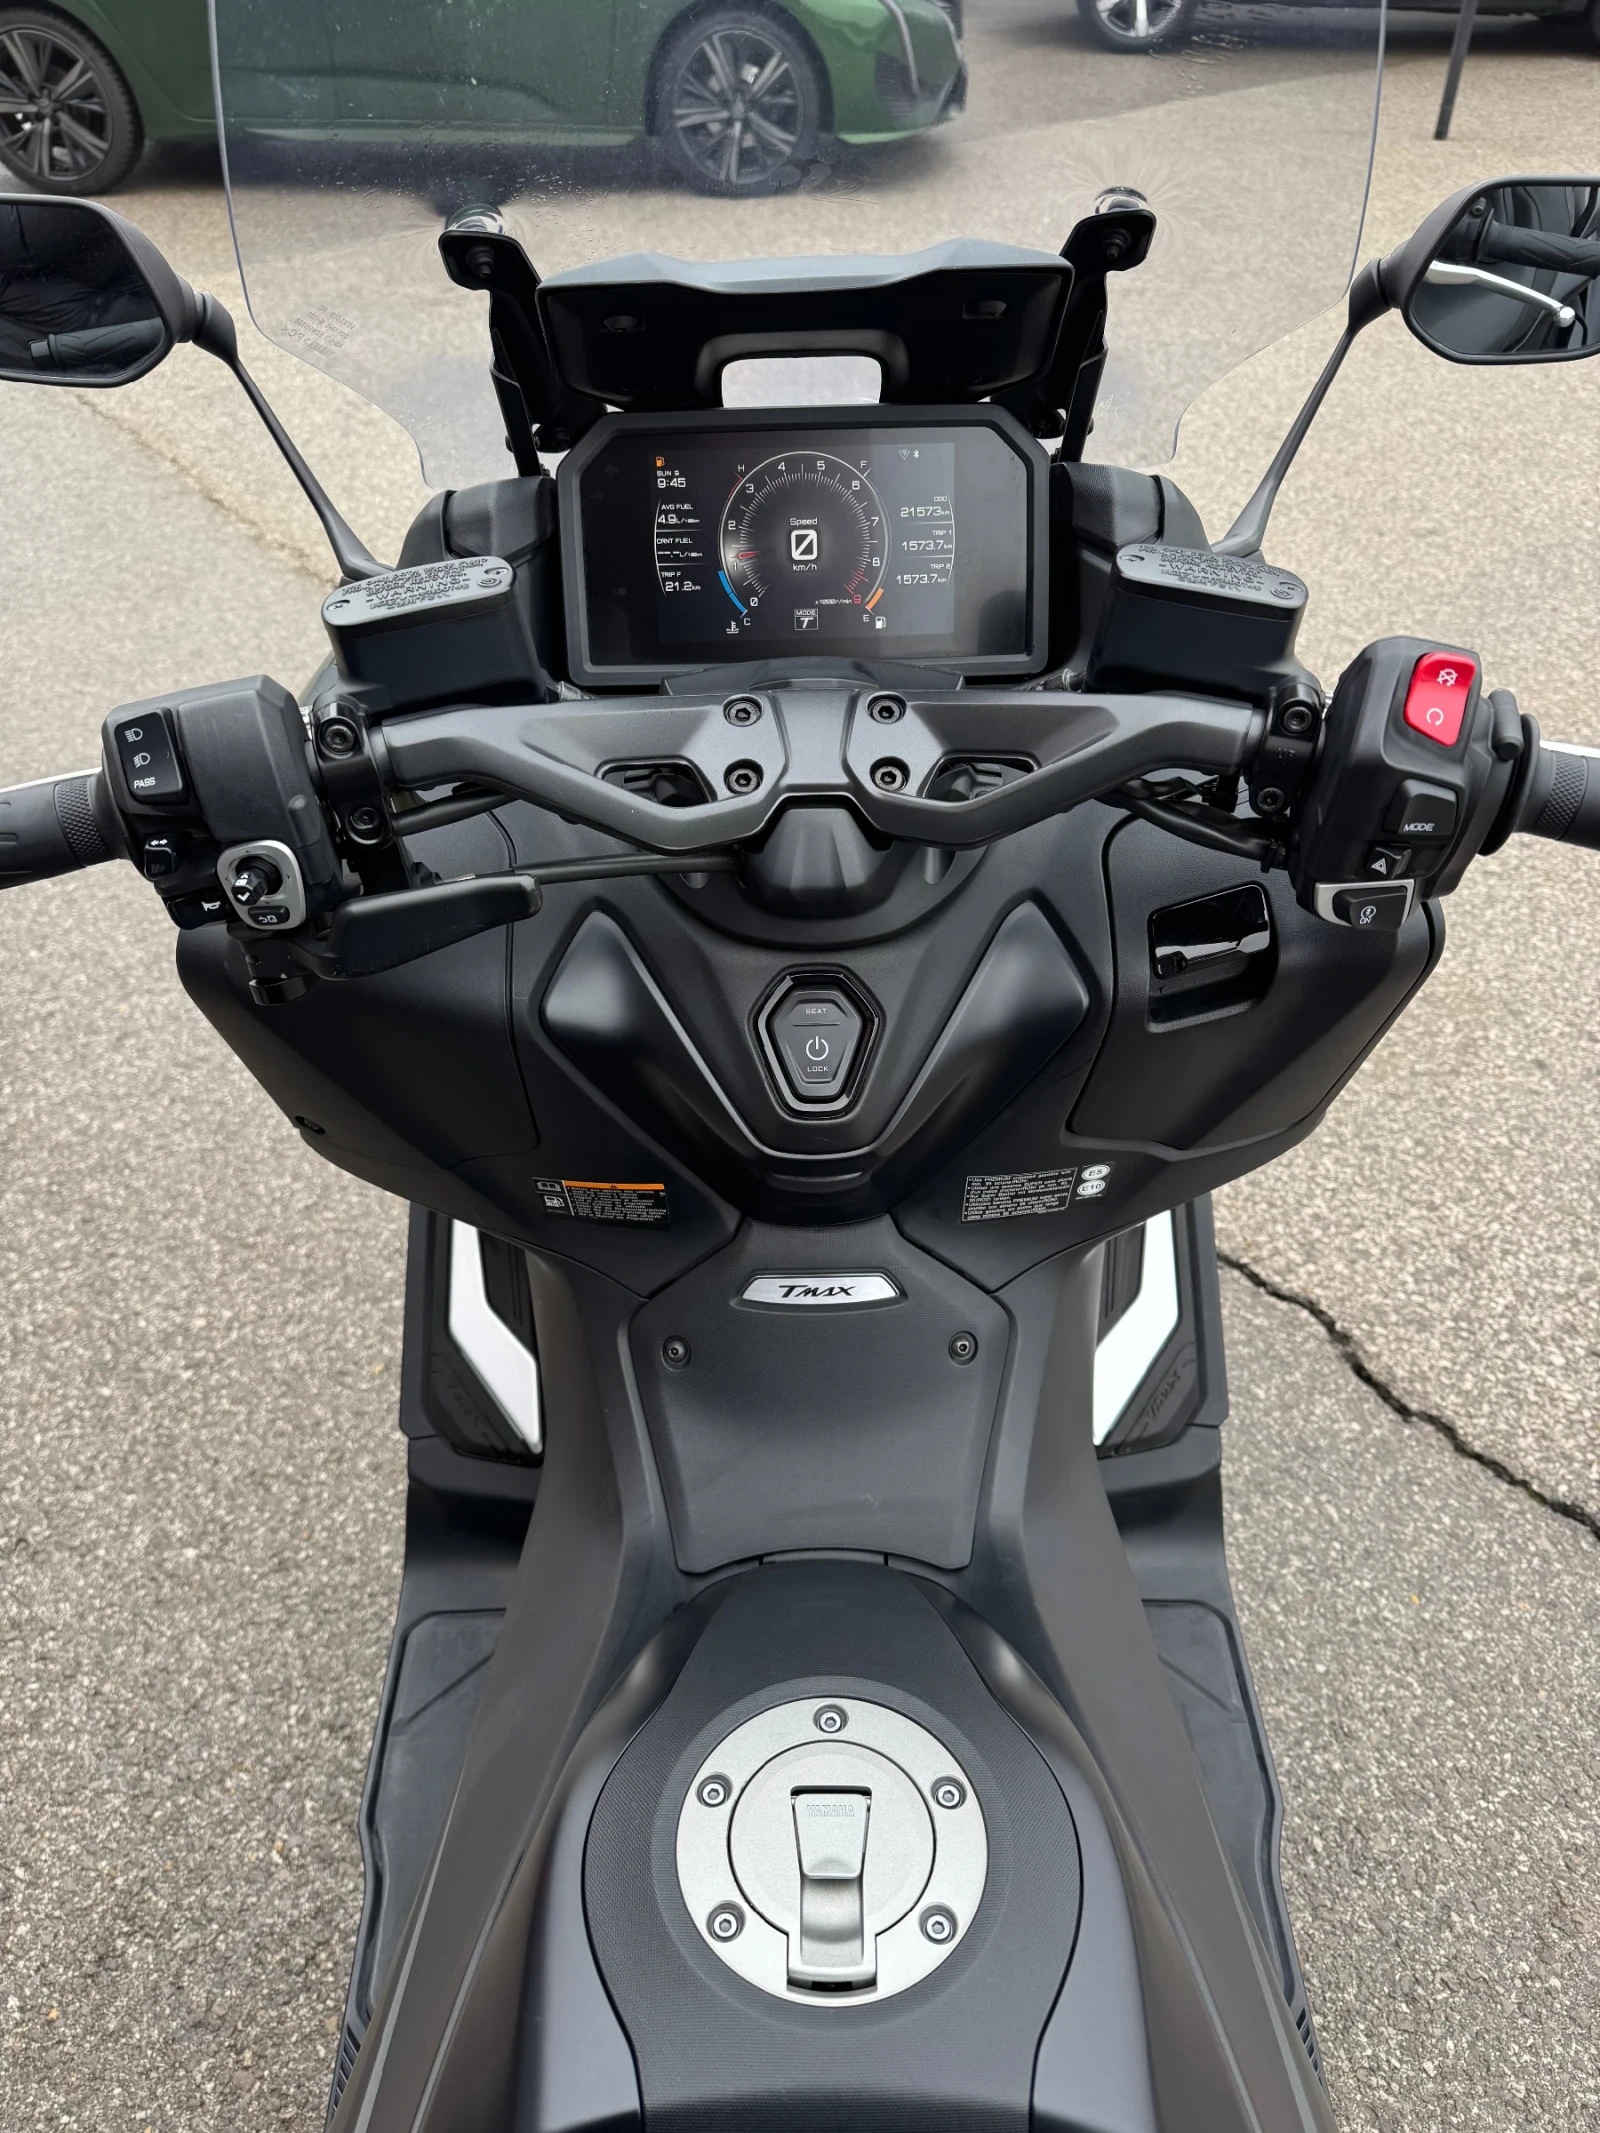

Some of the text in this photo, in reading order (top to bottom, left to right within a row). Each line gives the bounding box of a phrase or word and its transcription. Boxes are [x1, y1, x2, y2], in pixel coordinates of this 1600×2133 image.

[778, 462, 785, 471] 4
[817, 461, 826, 470] 5
[658, 478, 686, 488] 9:45
[852, 481, 860, 490] 6
[746, 484, 754, 493] 3
[728, 520, 736, 530] 2
[789, 518, 818, 526] Speed
[871, 517, 879, 526] 7
[791, 529, 818, 560] 0
[732, 562, 738, 571] 1
[872, 558, 880, 566] 8
[793, 563, 817, 571] km/h
[750, 597, 758, 606] 0
[854, 595, 861, 603] 9
[800, 617, 814, 628] T
[863, 614, 869, 622] E
[134, 777, 156, 789] PASS
[1404, 823, 1435, 832] MODE
[1088, 1168, 1103, 1176] E5
[1082, 1184, 1101, 1192] E10
[807, 1804, 855, 1817] YAMAHA
